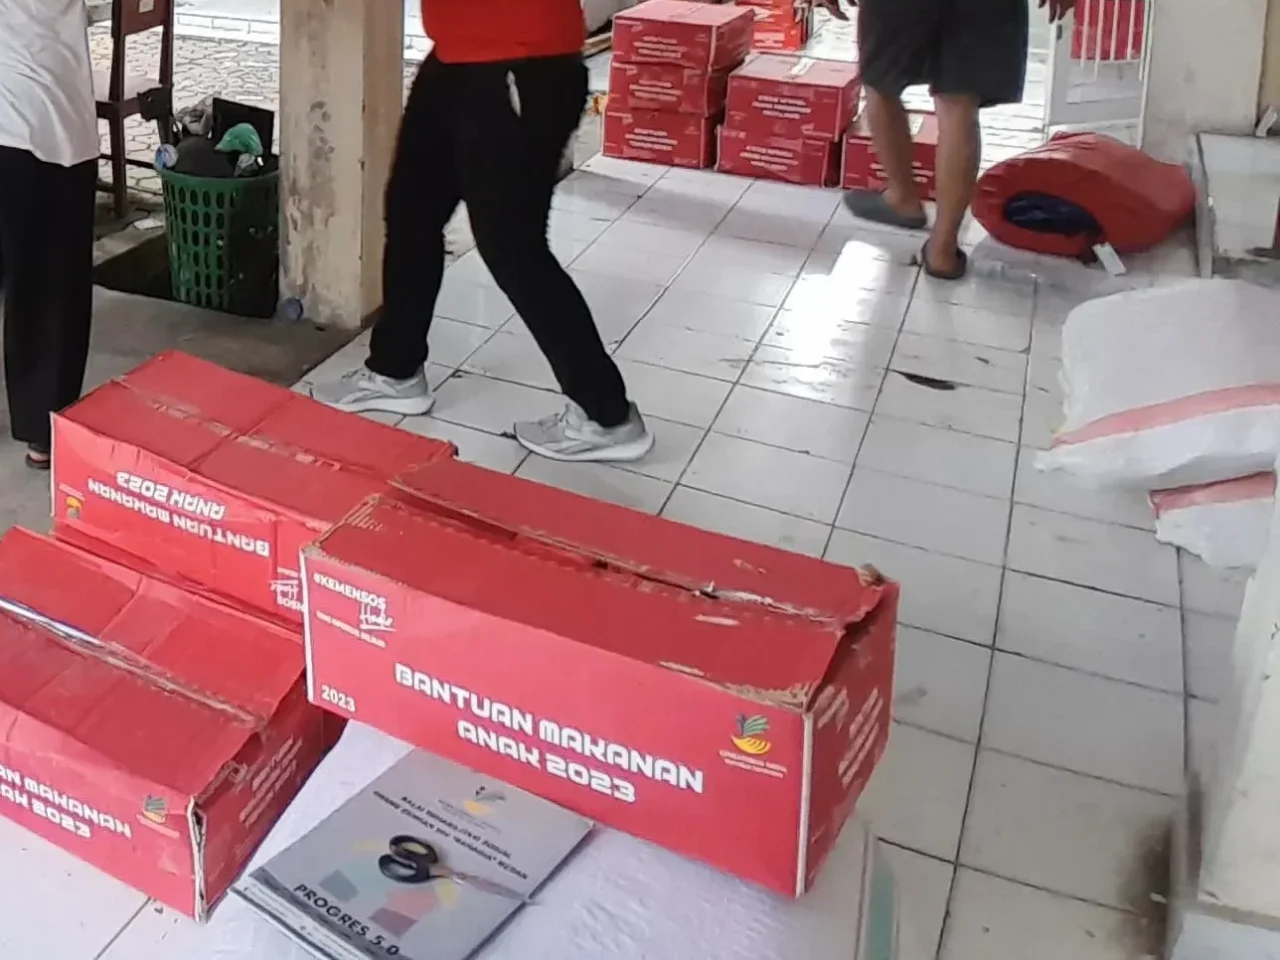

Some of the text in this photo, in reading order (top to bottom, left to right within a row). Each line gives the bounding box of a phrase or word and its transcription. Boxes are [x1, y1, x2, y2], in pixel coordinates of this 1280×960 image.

[88, 478, 171, 524] MAKANAN
[116, 471, 169, 502] 2023
[170, 492, 226, 520] ANAK
[172, 514, 270, 558] BANTUAN
[321, 684, 357, 714] 2023
[394, 662, 533, 736] BANTUAN
[538, 718, 704, 794] MAKANAN
[457, 719, 637, 804] ANAK 2023
[24, 778, 132, 838] MAKANAN
[32, 798, 91, 838] 2023
[293, 883, 376, 939] PROGRES
